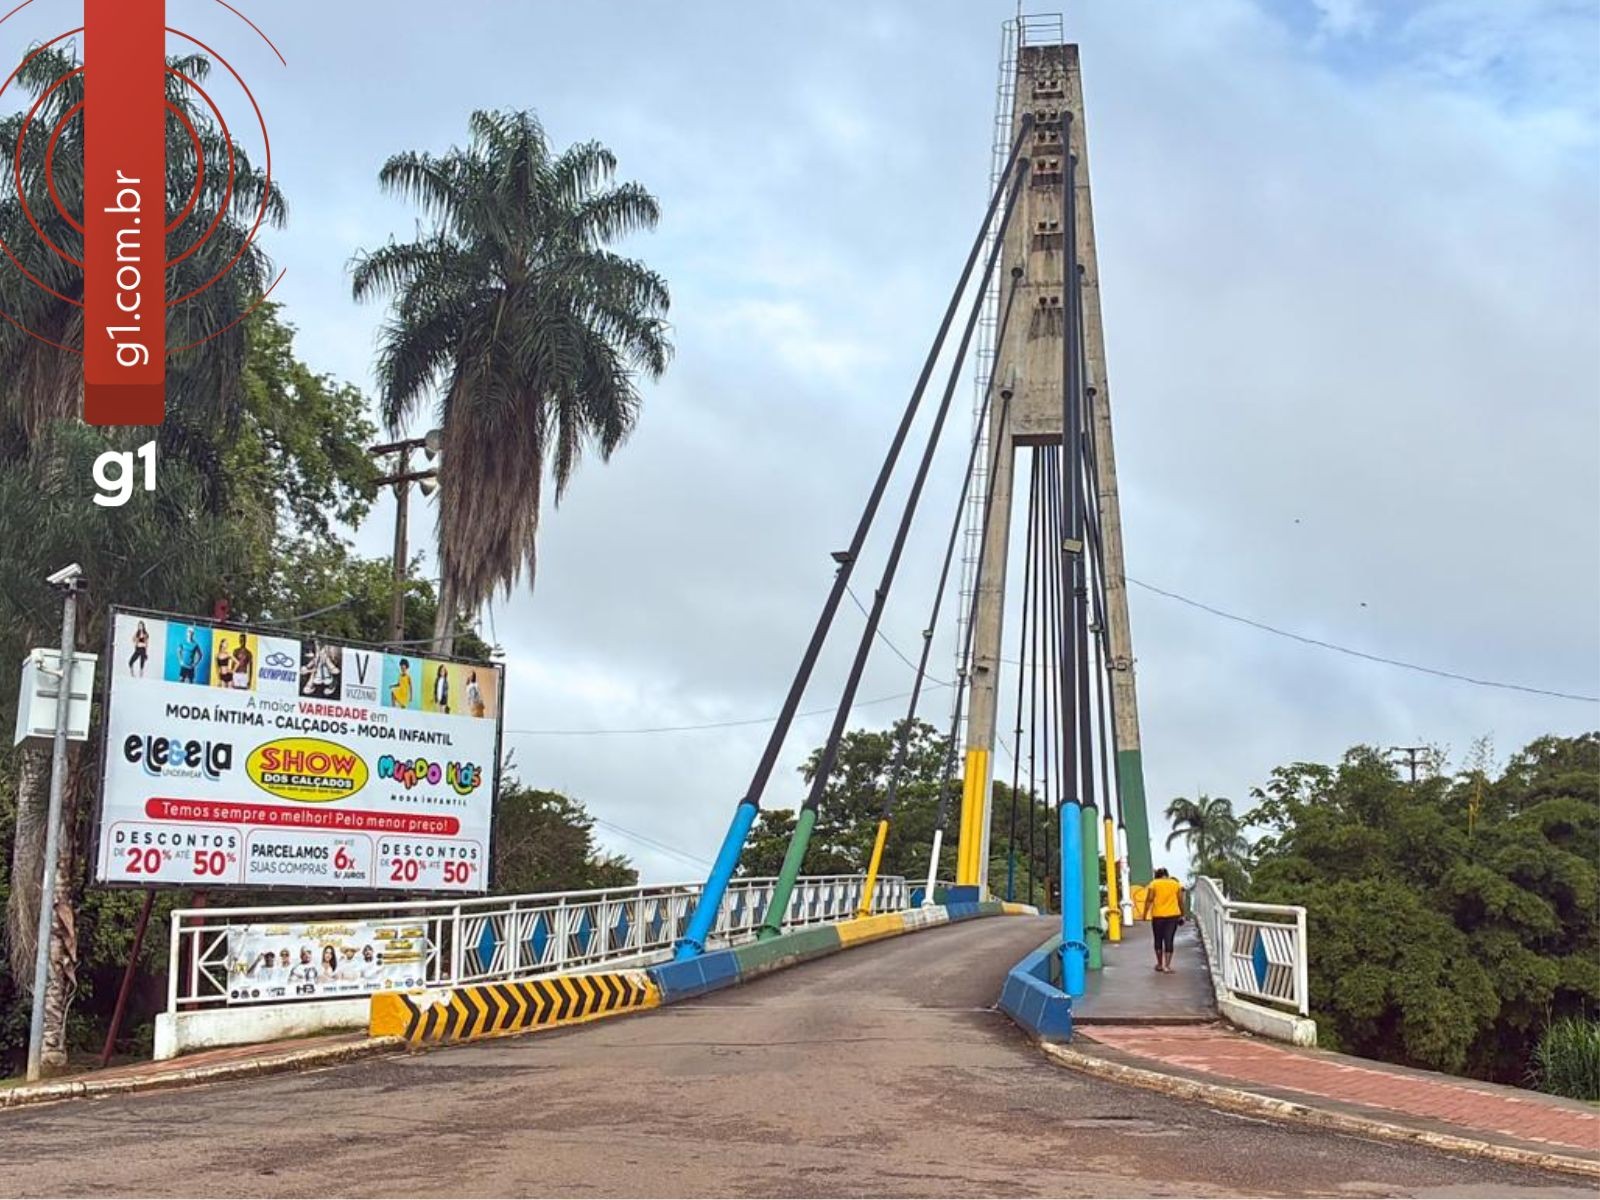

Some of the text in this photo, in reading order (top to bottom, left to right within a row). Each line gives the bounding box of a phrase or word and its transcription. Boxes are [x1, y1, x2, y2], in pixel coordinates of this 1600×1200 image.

[246, 696, 388, 723] A maior VARIEDADE em
[165, 703, 211, 721] MODA
[213, 704, 265, 726] ÍNTIMA
[275, 715, 348, 735] CALÇADOS
[357, 724, 397, 740] MODA
[398, 728, 453, 746] INFANTIL
[260, 747, 357, 775] SHOW
[263, 773, 353, 788] DOS CALÇADOS
[390, 793, 418, 802] MODA
[162, 802, 449, 832] Temos sempre o melhor! Pelo menor preço!
[115, 830, 237, 848] DESCONTOS
[125, 847, 172, 874] 20%
[174, 850, 190, 859] ATÉ
[193, 850, 237, 876] 50%
[251, 843, 329, 860] PARCELAMOS
[382, 844, 477, 860] DESCONTOS
[250, 861, 329, 875] SUAS COMPRAS
[390, 858, 427, 882] 20%
[443, 861, 478, 884] 50%
